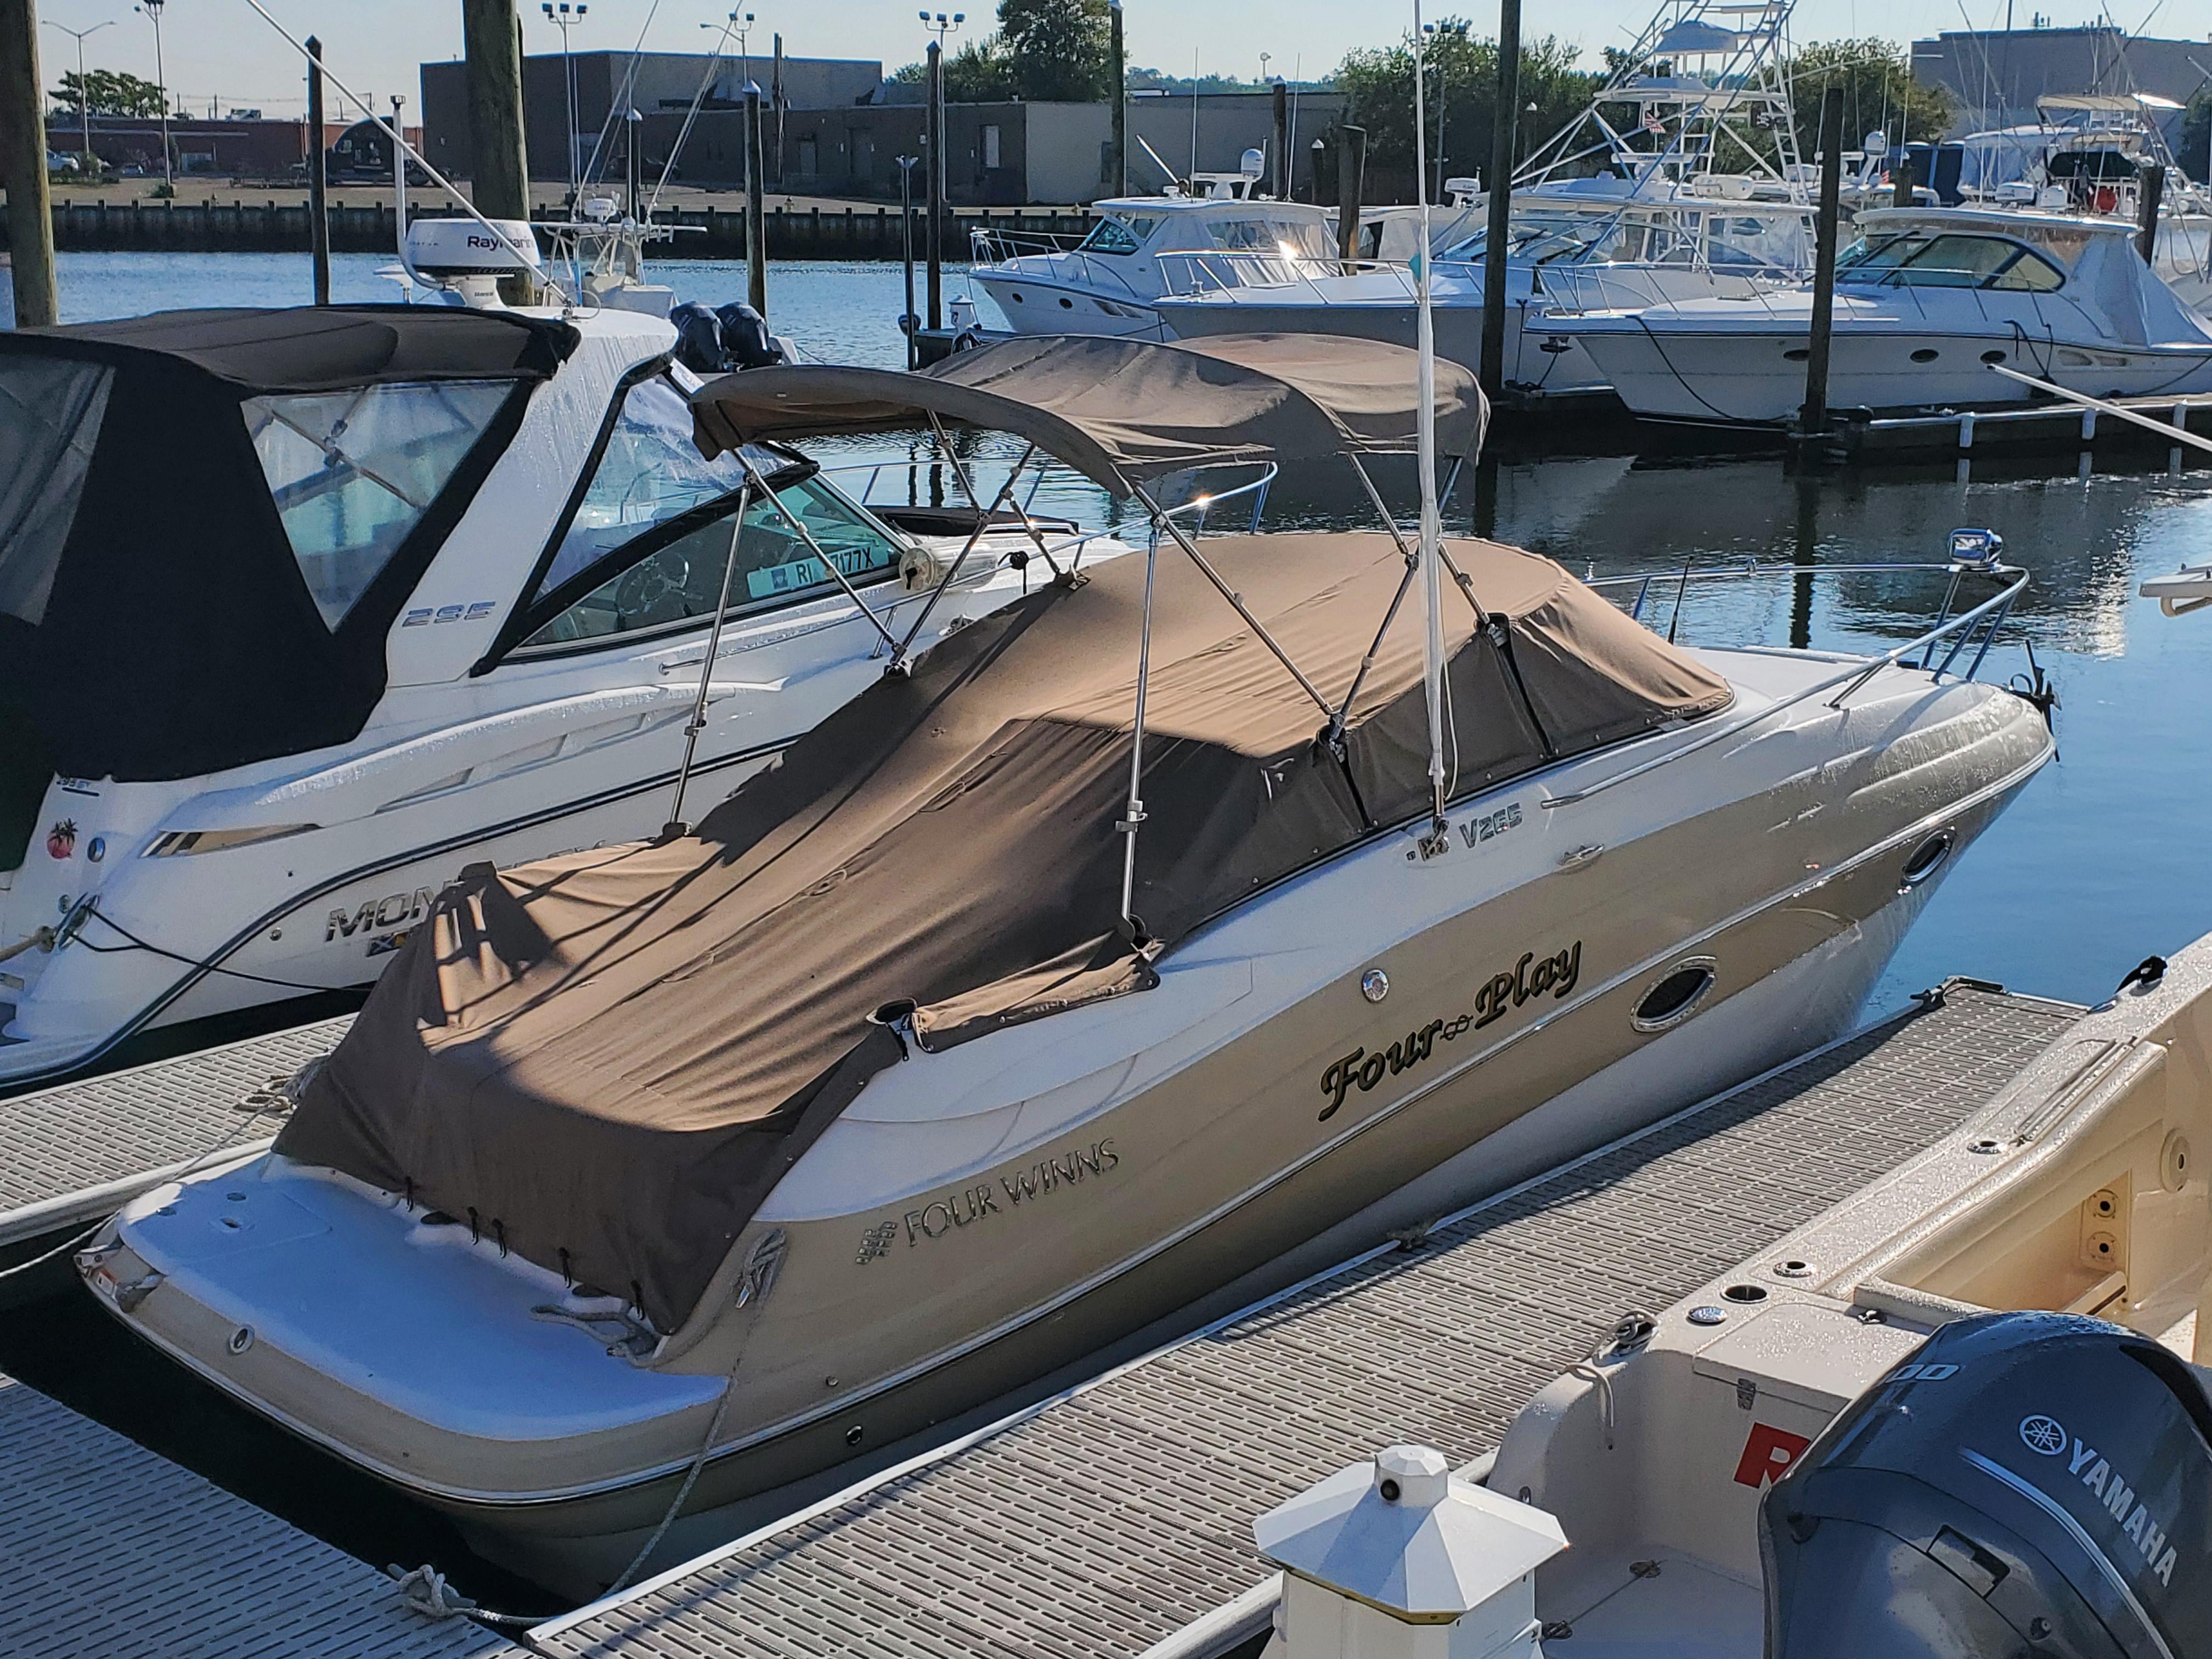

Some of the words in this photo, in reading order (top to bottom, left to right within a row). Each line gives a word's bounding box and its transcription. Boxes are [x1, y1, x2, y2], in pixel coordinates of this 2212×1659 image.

[795, 563, 812, 584] RI
[1459, 802, 1523, 849] V265
[325, 880, 453, 942] MON
[1318, 1018, 1443, 1122] Four
[1474, 940, 1582, 1030] Play
[904, 1184, 1003, 1248] FOUR
[1000, 1137, 1120, 1206] WINNS
[2067, 1437, 2177, 1588] YAMAHA
